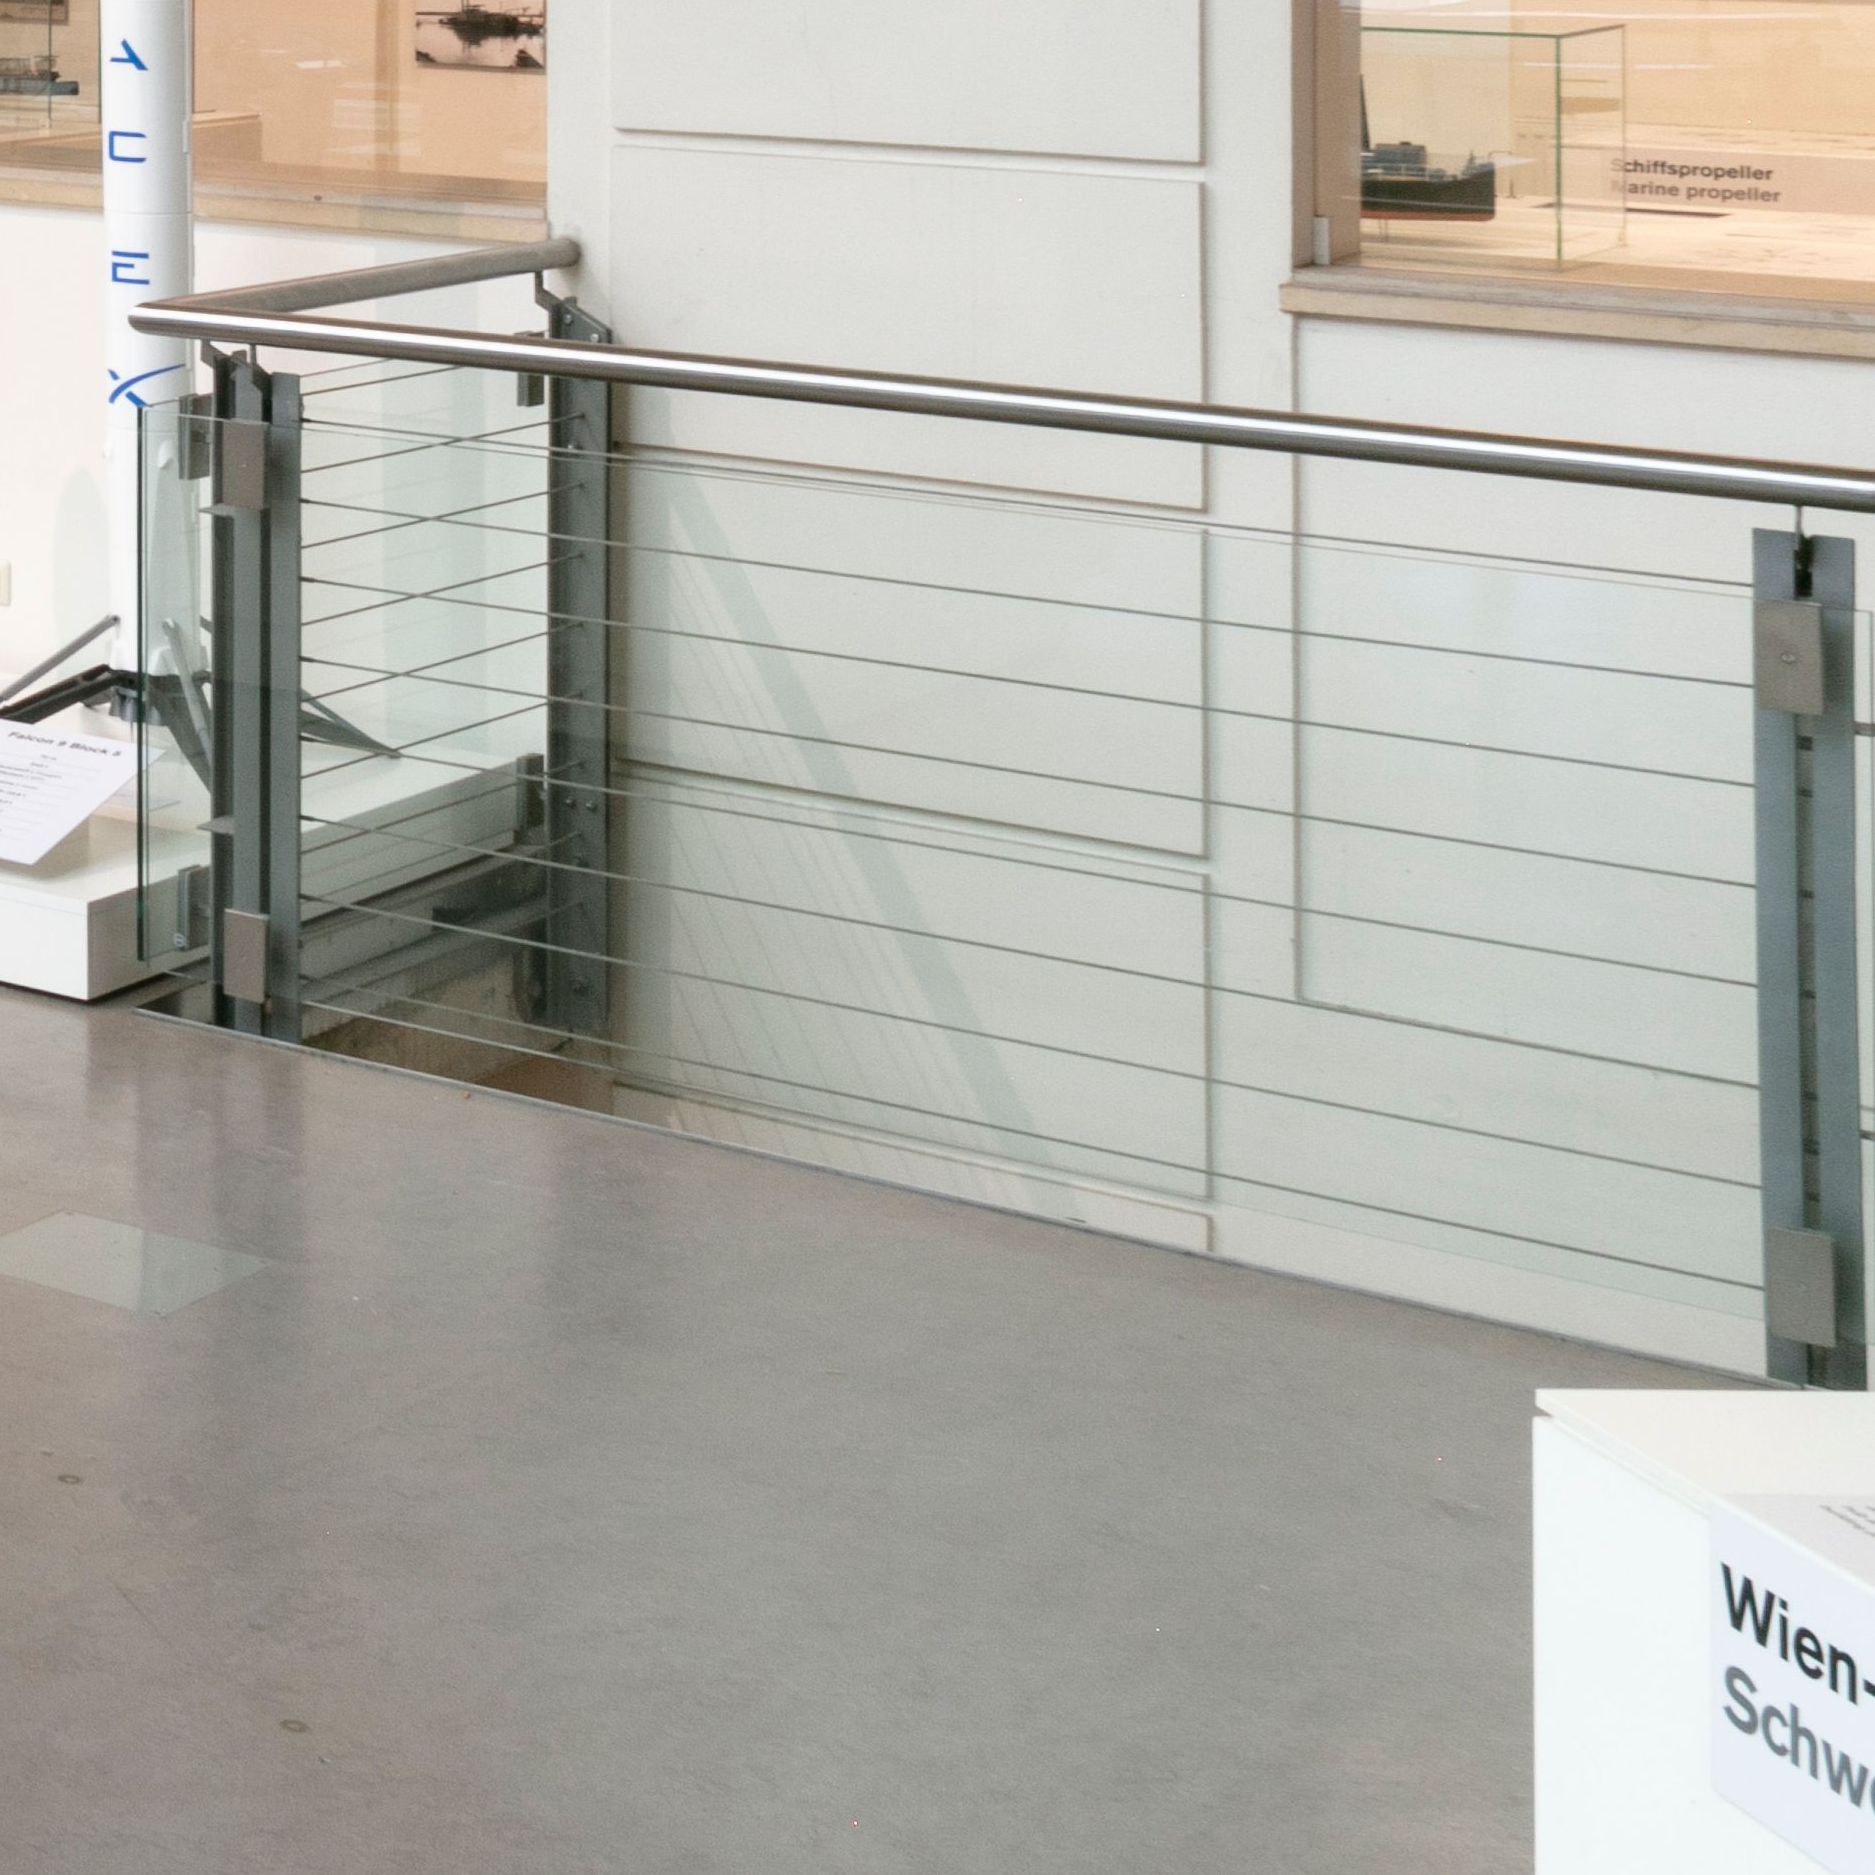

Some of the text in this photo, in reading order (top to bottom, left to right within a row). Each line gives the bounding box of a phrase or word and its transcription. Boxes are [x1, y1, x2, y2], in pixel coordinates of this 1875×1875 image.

[1686, 185, 1782, 203] propeller
[8, 731, 55, 746] Falcon
[69, 742, 108, 756] Block
[1720, 1561, 1875, 1706] Wien-
[1723, 1666, 1875, 1816] Schw
